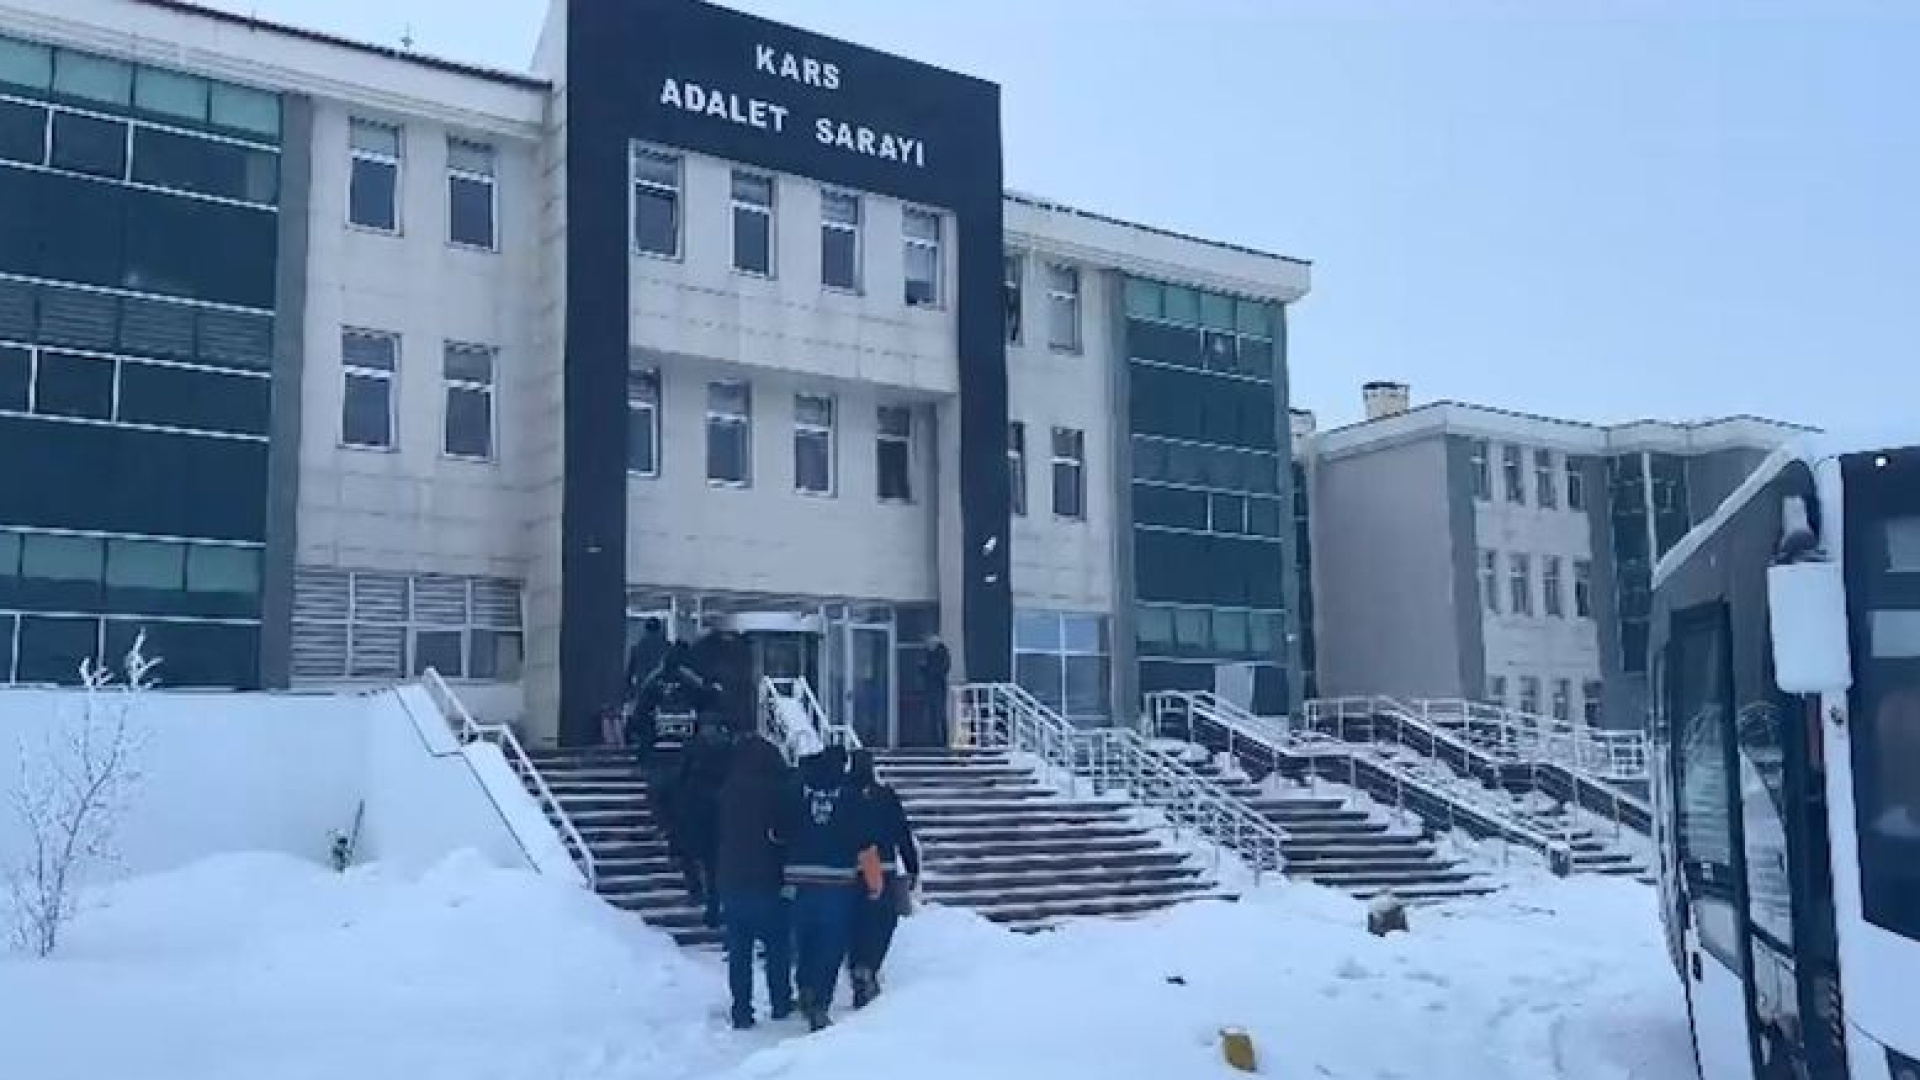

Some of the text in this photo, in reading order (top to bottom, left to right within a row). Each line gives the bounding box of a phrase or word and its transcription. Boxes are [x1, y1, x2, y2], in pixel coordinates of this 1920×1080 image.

[756, 44, 840, 89] KARS
[660, 78, 925, 167] ADALET SARAYI
